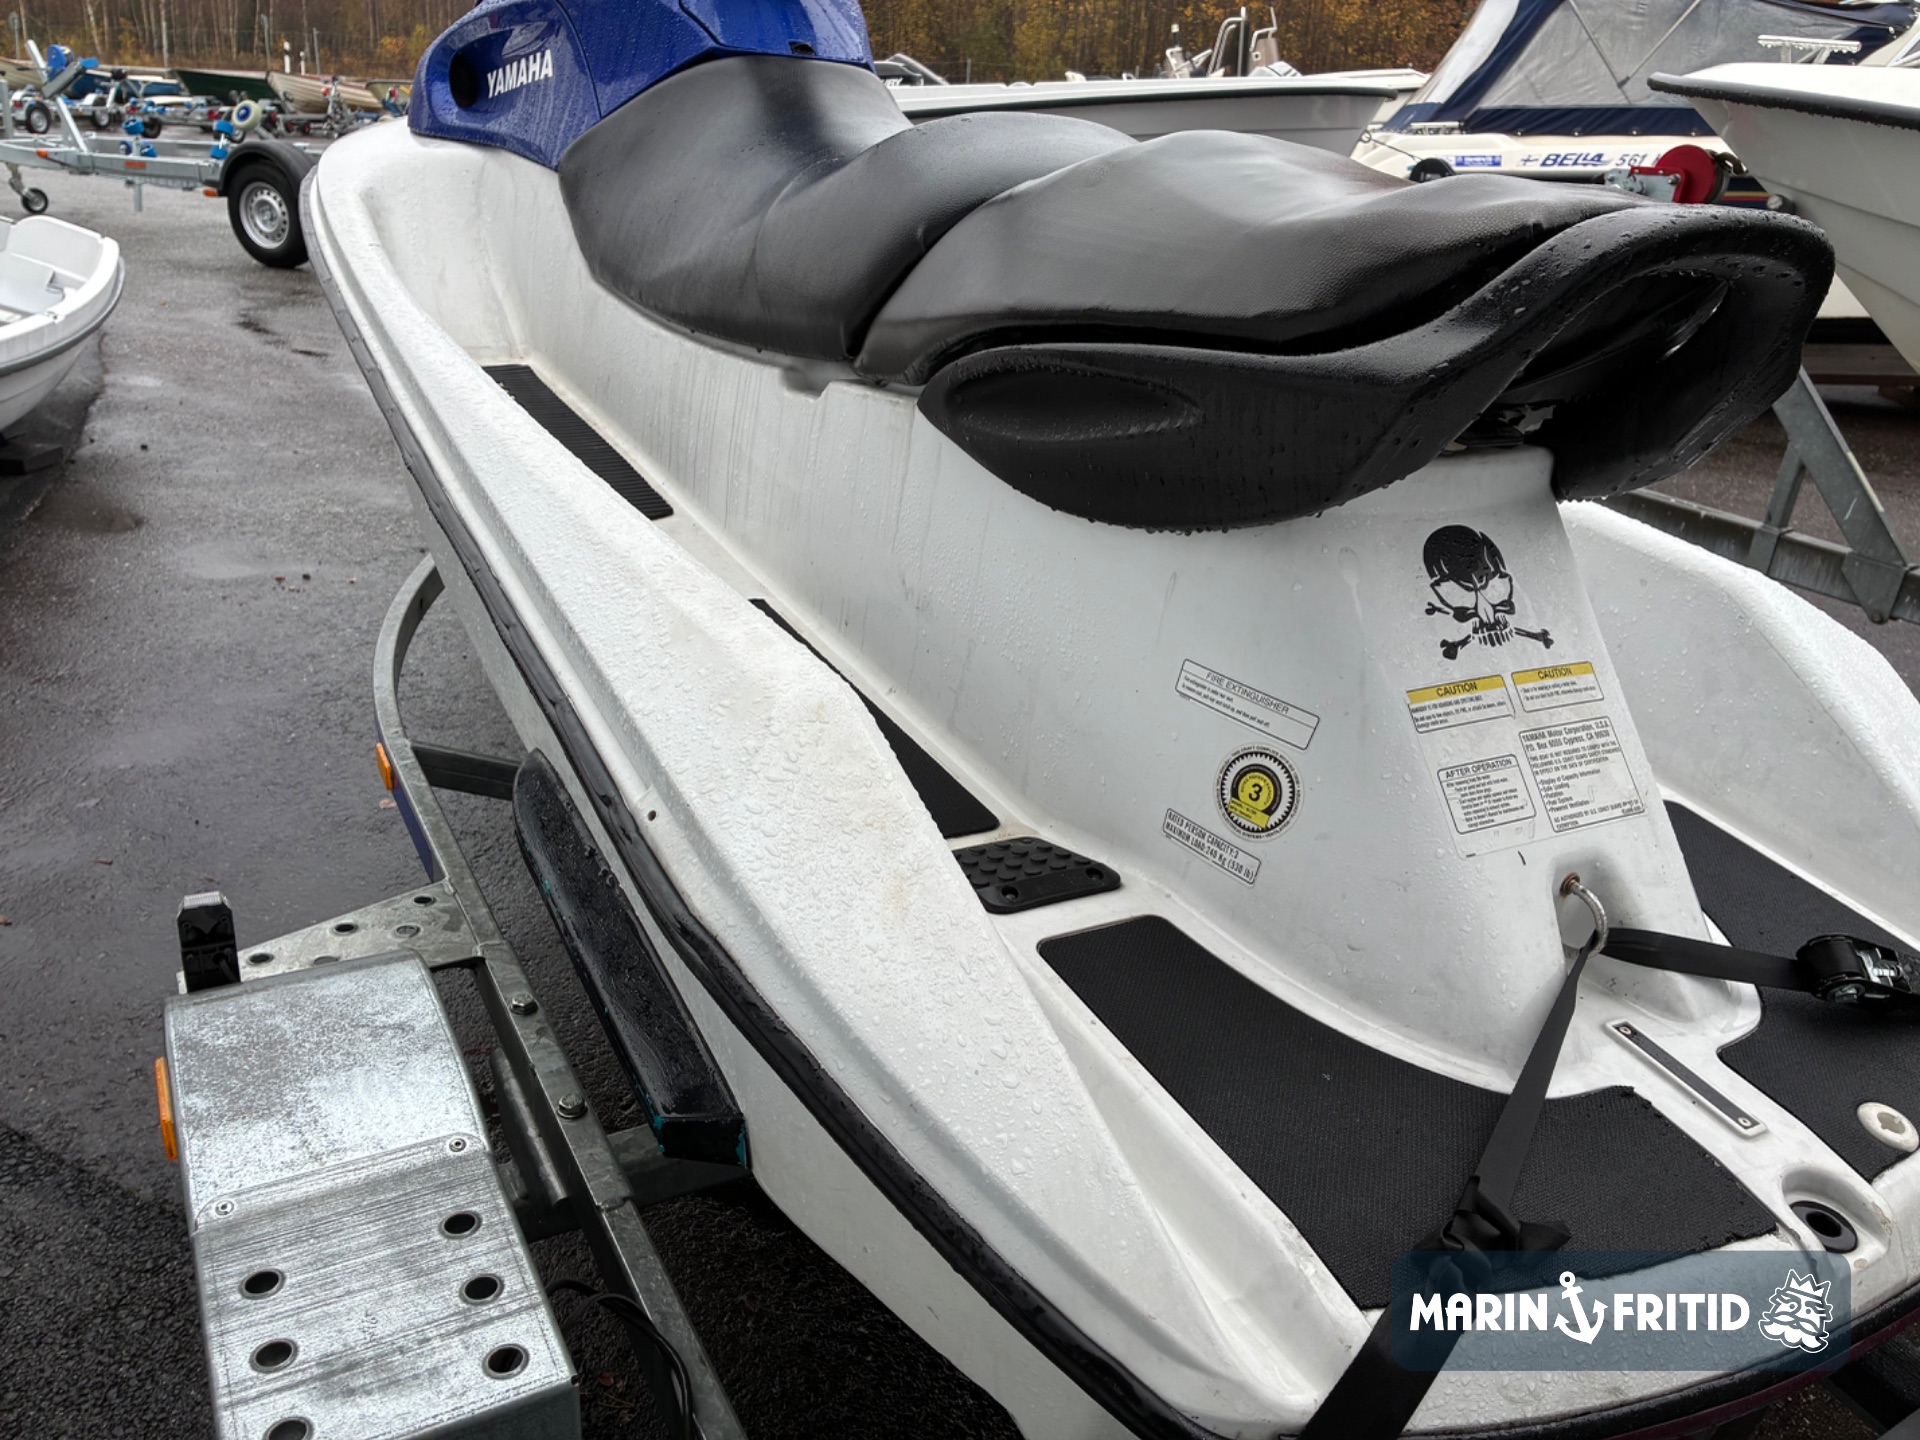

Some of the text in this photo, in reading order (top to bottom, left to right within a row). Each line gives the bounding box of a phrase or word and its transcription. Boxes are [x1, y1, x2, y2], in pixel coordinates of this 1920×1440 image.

[487, 49, 553, 99] YAMAHA
[1540, 153, 1605, 167] BELLA
[1615, 153, 1647, 167] 561
[1538, 668, 1573, 680] CAUTION
[1205, 672, 1226, 686] FIRE
[1226, 681, 1290, 714] EXTINGUISHER
[1436, 682, 1478, 697] CAUTION
[1446, 758, 1512, 778] AFTER OPERATION
[1248, 784, 1263, 802] 3
[1184, 822, 1207, 840] PERSON
